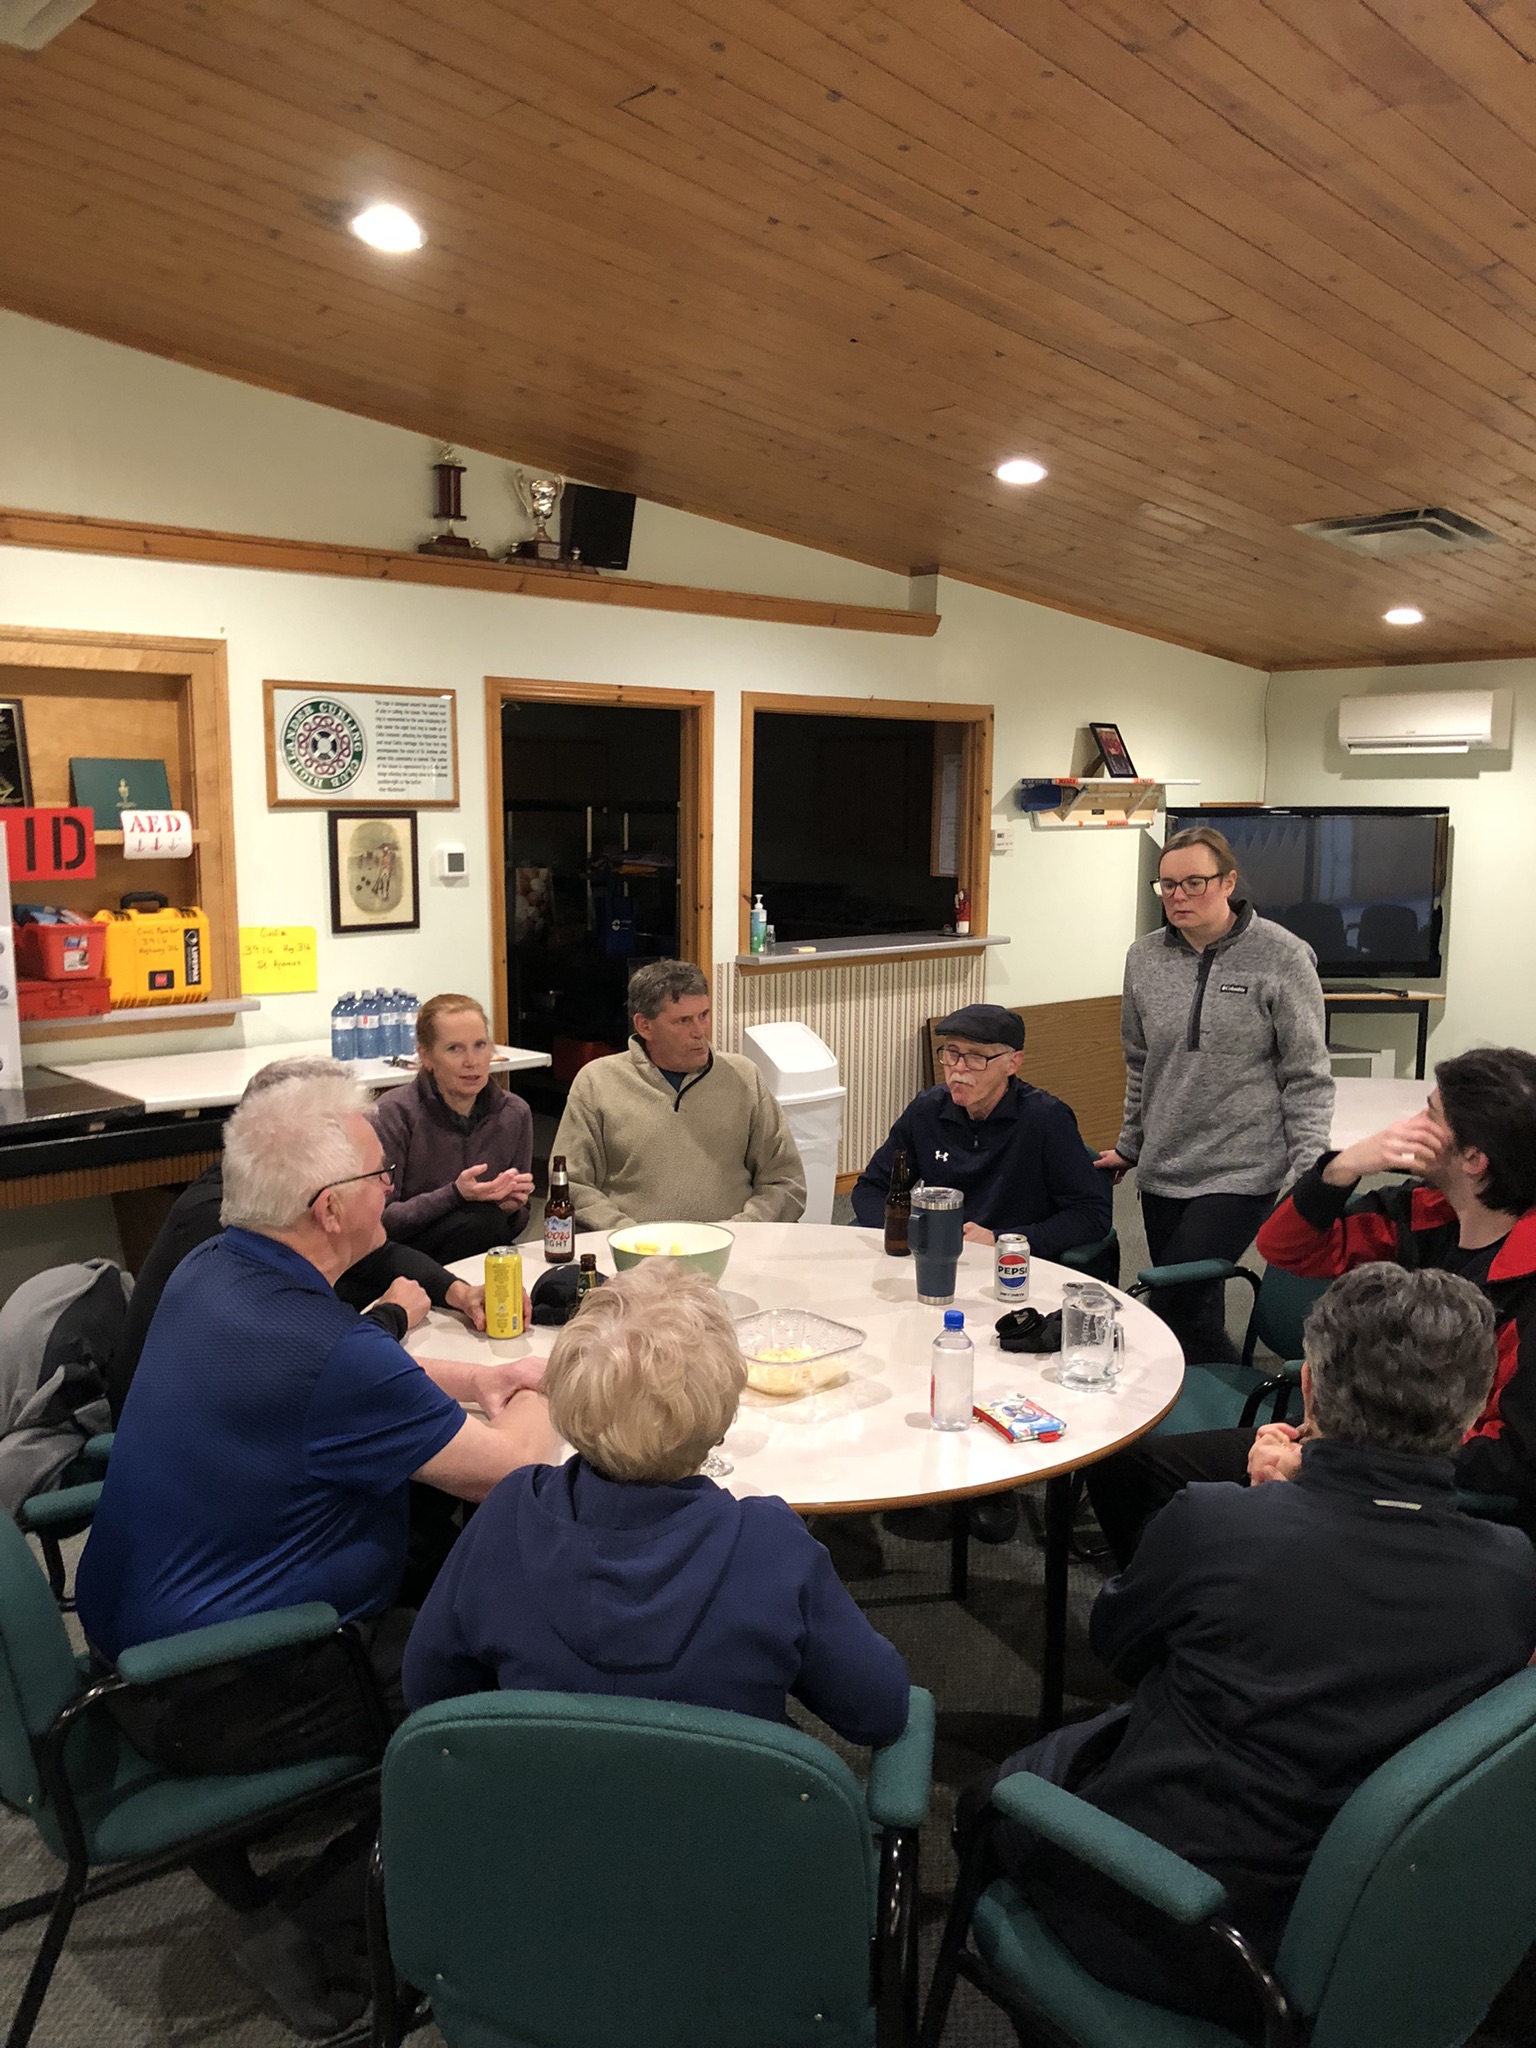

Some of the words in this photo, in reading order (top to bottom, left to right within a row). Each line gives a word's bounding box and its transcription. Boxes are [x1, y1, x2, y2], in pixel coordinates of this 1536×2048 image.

[319, 702, 363, 752] CURLING
[285, 704, 324, 788] HIGHLANDER
[330, 759, 361, 788] CLUB
[129, 814, 182, 834] AED
[242, 944, 273, 956] 3916
[997, 1265, 1028, 1276] PEPSI
